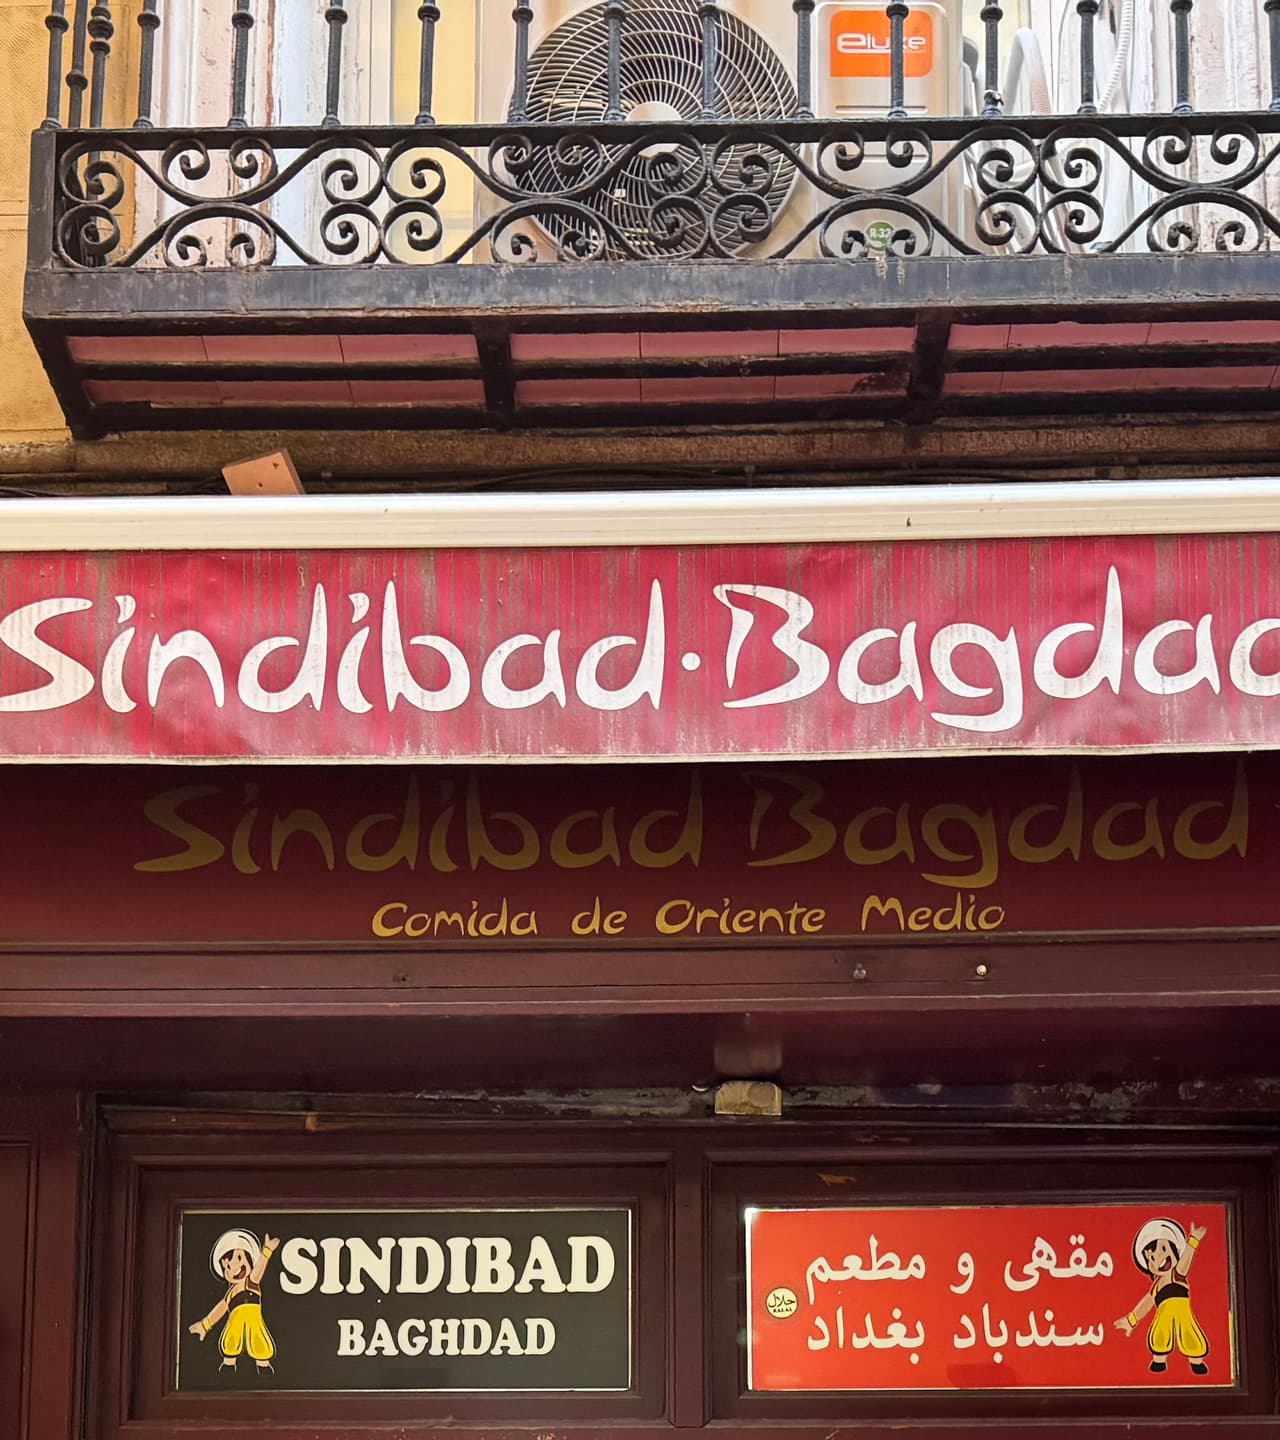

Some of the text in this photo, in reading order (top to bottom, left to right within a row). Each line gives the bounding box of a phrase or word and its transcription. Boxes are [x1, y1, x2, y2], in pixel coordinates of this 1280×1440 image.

[837, 33, 926, 54] elue
[132, 757, 1250, 888] Sindibad Bagdad
[371, 892, 1006, 938] Comida de Oriente Medio
[279, 1235, 616, 1295] SINDIBAD
[805, 1234, 926, 1305] مطعم
[949, 1251, 975, 1294] و
[337, 1317, 556, 1357] BAGHDAD
[807, 1302, 1105, 1365] سندباد بغداد
